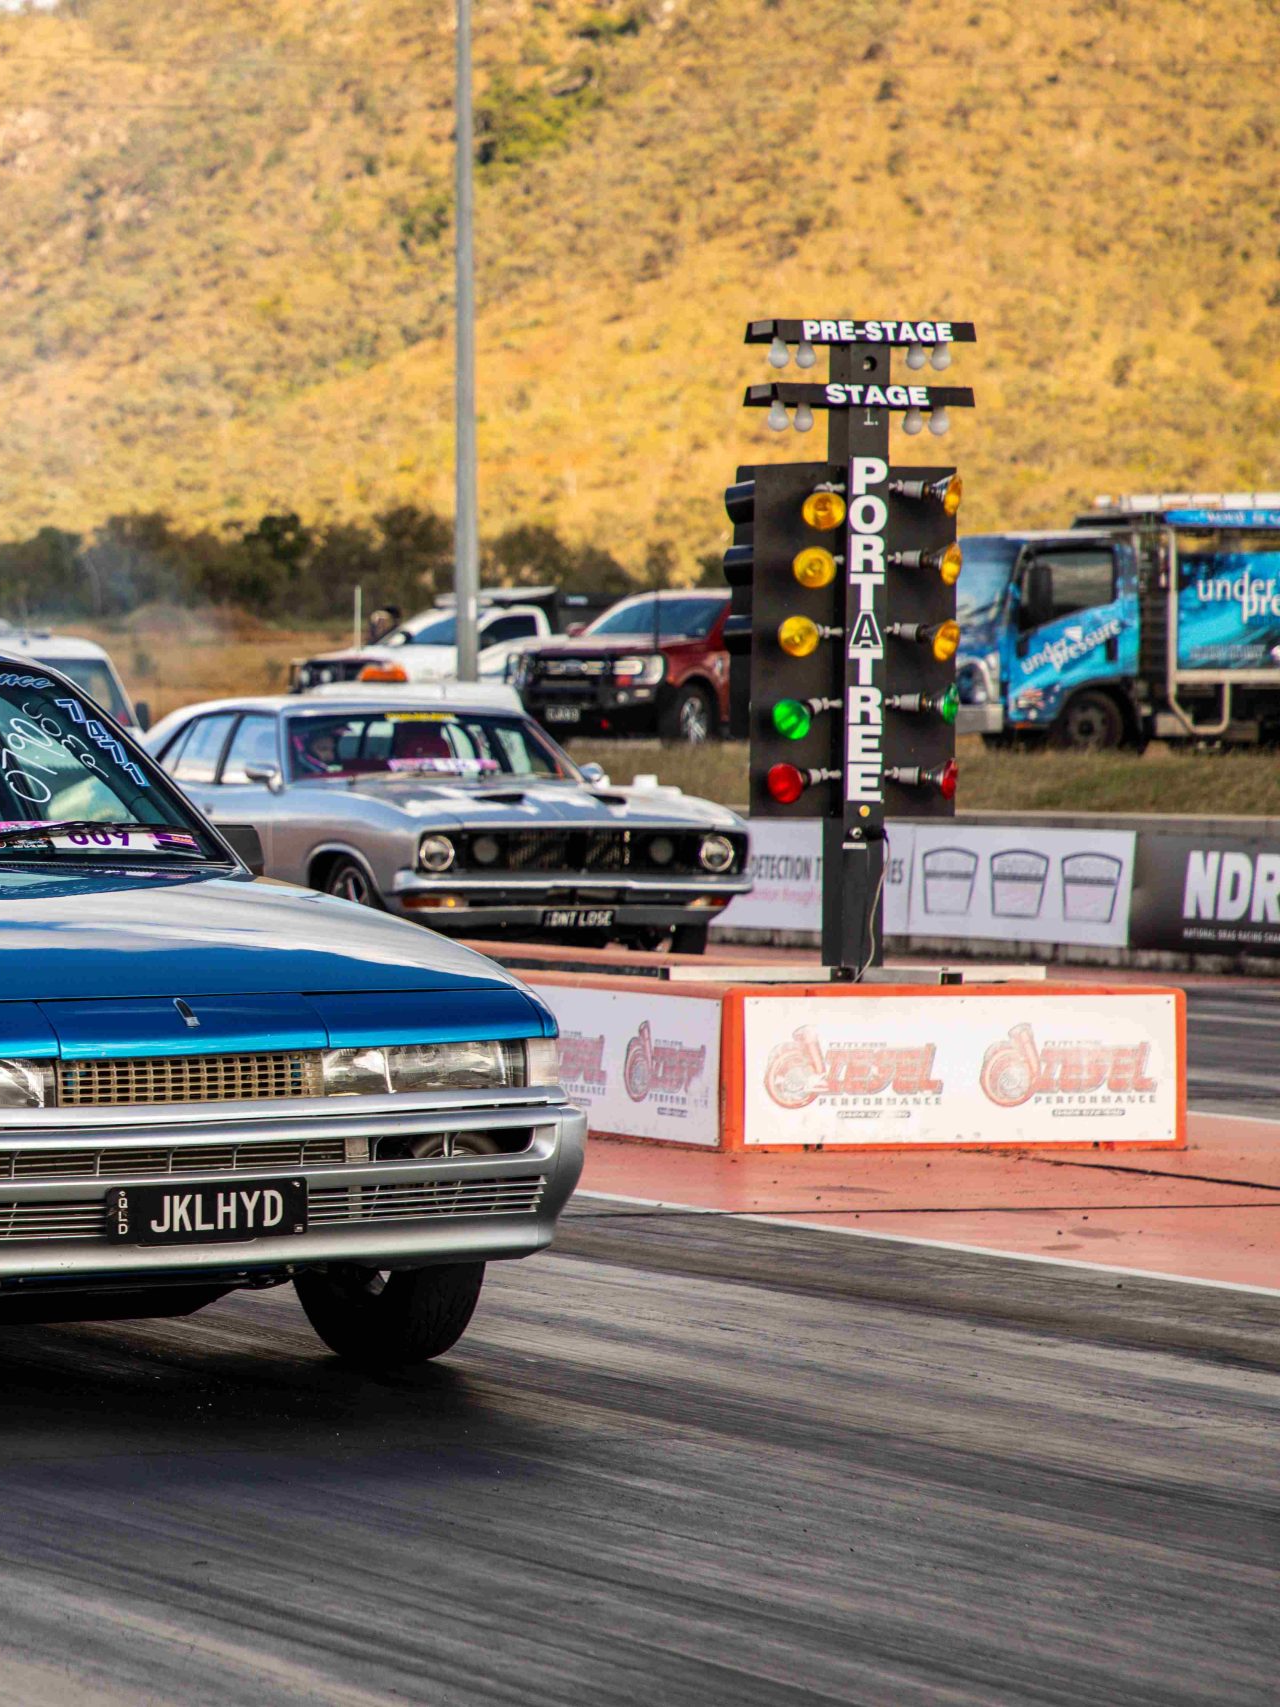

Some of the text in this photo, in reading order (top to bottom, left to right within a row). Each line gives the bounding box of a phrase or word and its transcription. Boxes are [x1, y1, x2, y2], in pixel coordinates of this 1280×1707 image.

[802, 320, 954, 342] PRE-STAGE
[825, 383, 930, 406] STAGE
[1197, 562, 1276, 602] under
[847, 456, 889, 802] PORTATREE
[751, 854, 812, 882] DETECTION
[818, 1096, 943, 1107] PERFORMANCE
[1033, 1094, 1157, 1105] PERFORMANCE
[118, 1197, 128, 1235] QLD
[150, 1189, 284, 1233] JKLHYD
